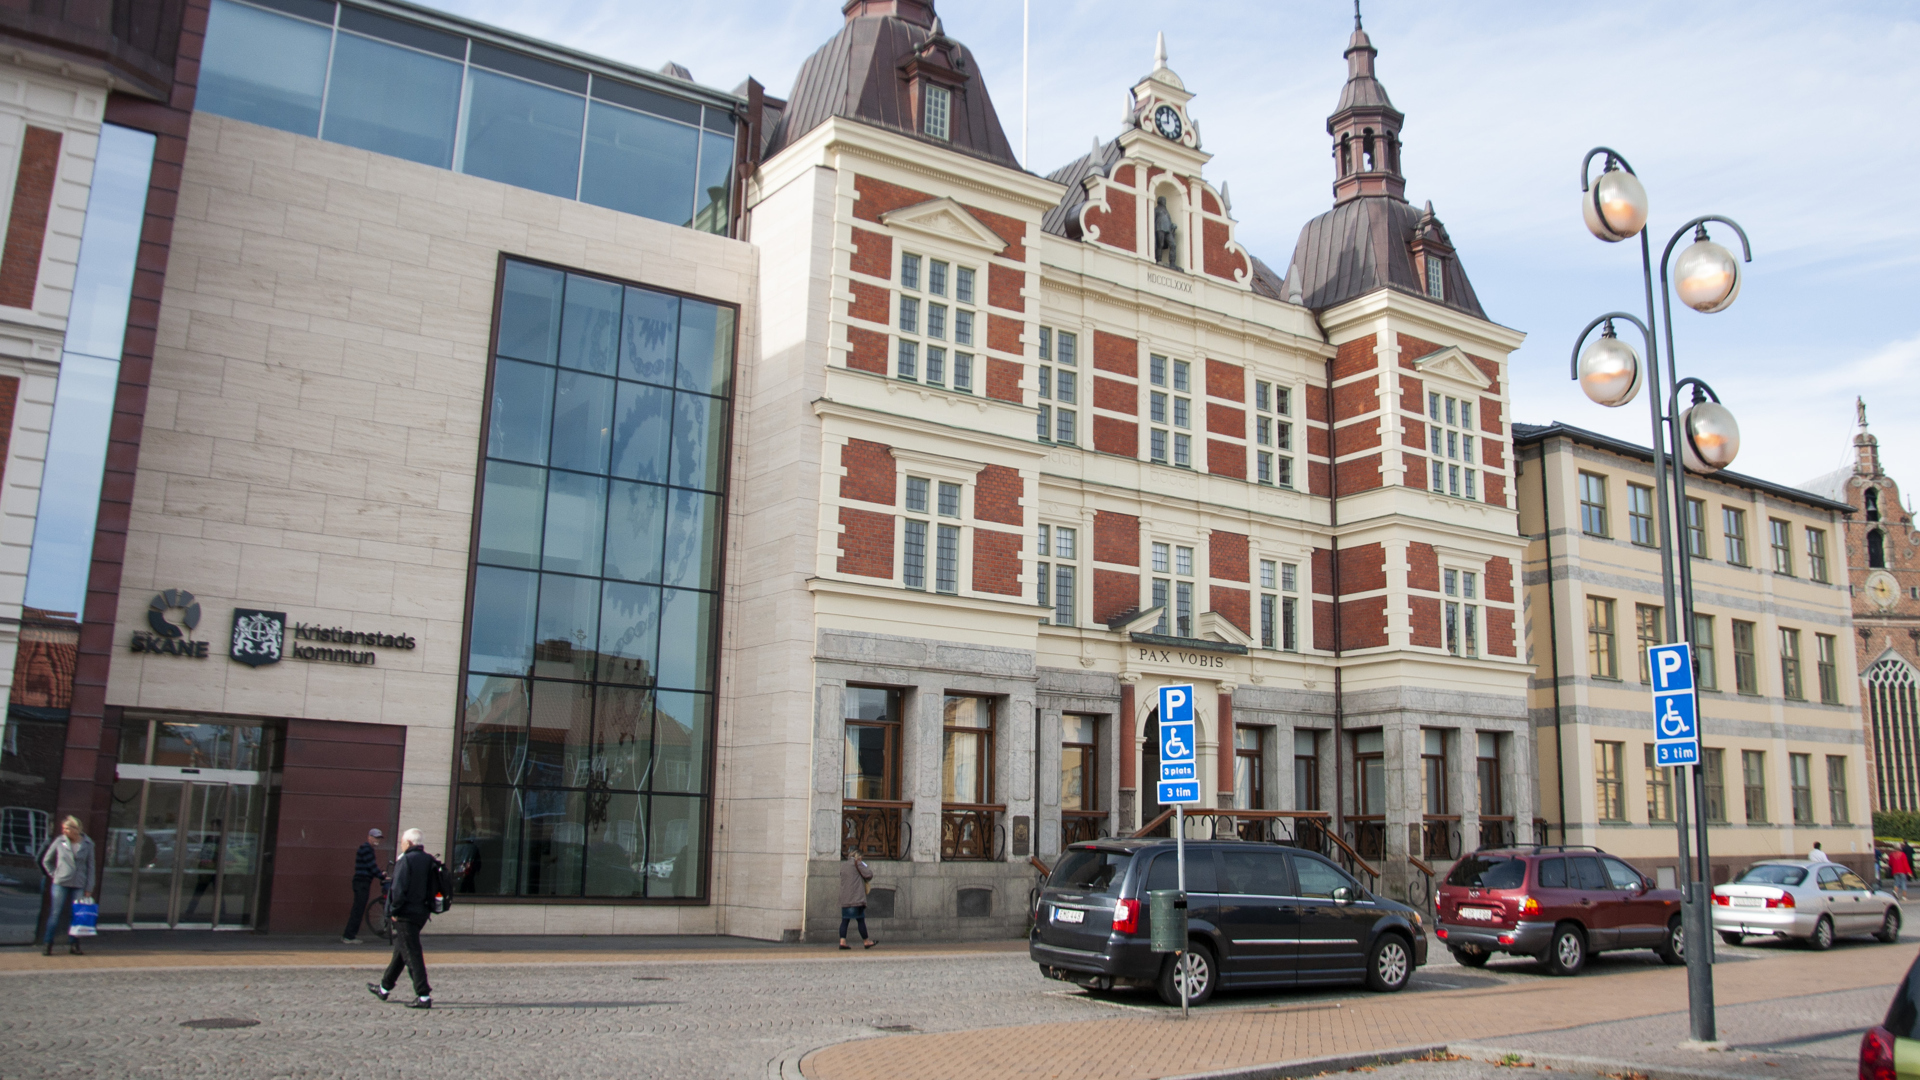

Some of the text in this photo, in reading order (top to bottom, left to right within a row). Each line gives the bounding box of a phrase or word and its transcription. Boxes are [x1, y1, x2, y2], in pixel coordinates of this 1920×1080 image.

[294, 622, 416, 650] Kristianstads
[292, 641, 376, 665] kommun
[1139, 648, 1224, 668] PAX VOBIS
[1657, 650, 1682, 688] P
[1166, 689, 1186, 720] P
[1661, 747, 1694, 760] 3 tim
[1164, 766, 1192, 777] 3 plats
[1167, 786, 1192, 798] 3 tim
